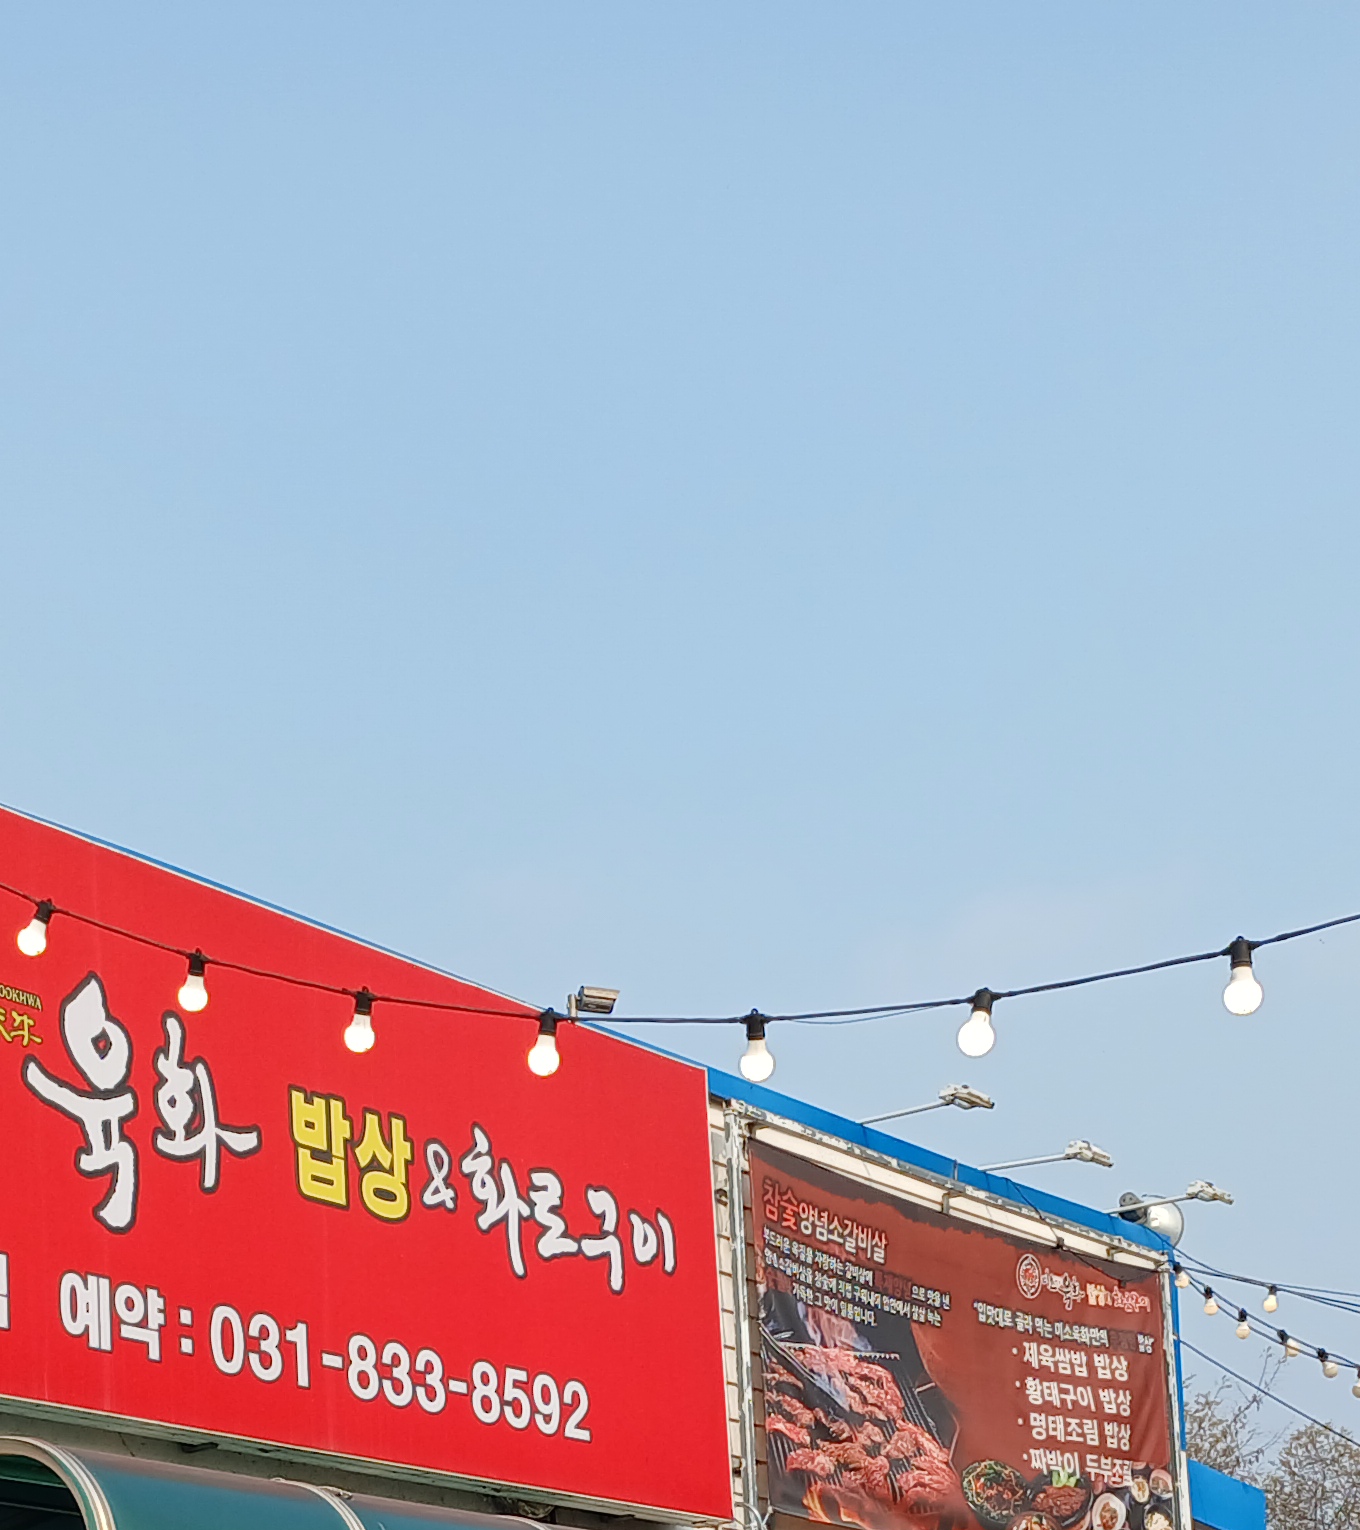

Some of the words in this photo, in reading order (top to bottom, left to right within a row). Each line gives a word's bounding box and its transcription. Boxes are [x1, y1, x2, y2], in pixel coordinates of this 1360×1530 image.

[288, 1084, 414, 1223] 밥상
[420, 1141, 457, 1212] &
[459, 1122, 677, 1295] 화로구이
[208, 1303, 592, 1444] 031-833-8592
[1023, 1341, 1089, 1378] 제육쌈밥
[1093, 1352, 1129, 1382] 밥상
[1025, 1376, 1096, 1412] 황태구이
[1099, 1388, 1132, 1417] 밥상
[1029, 1412, 1100, 1446] 명태조림
[1104, 1421, 1131, 1451] 밥상
[1085, 1453, 1133, 1486] 두부조림
